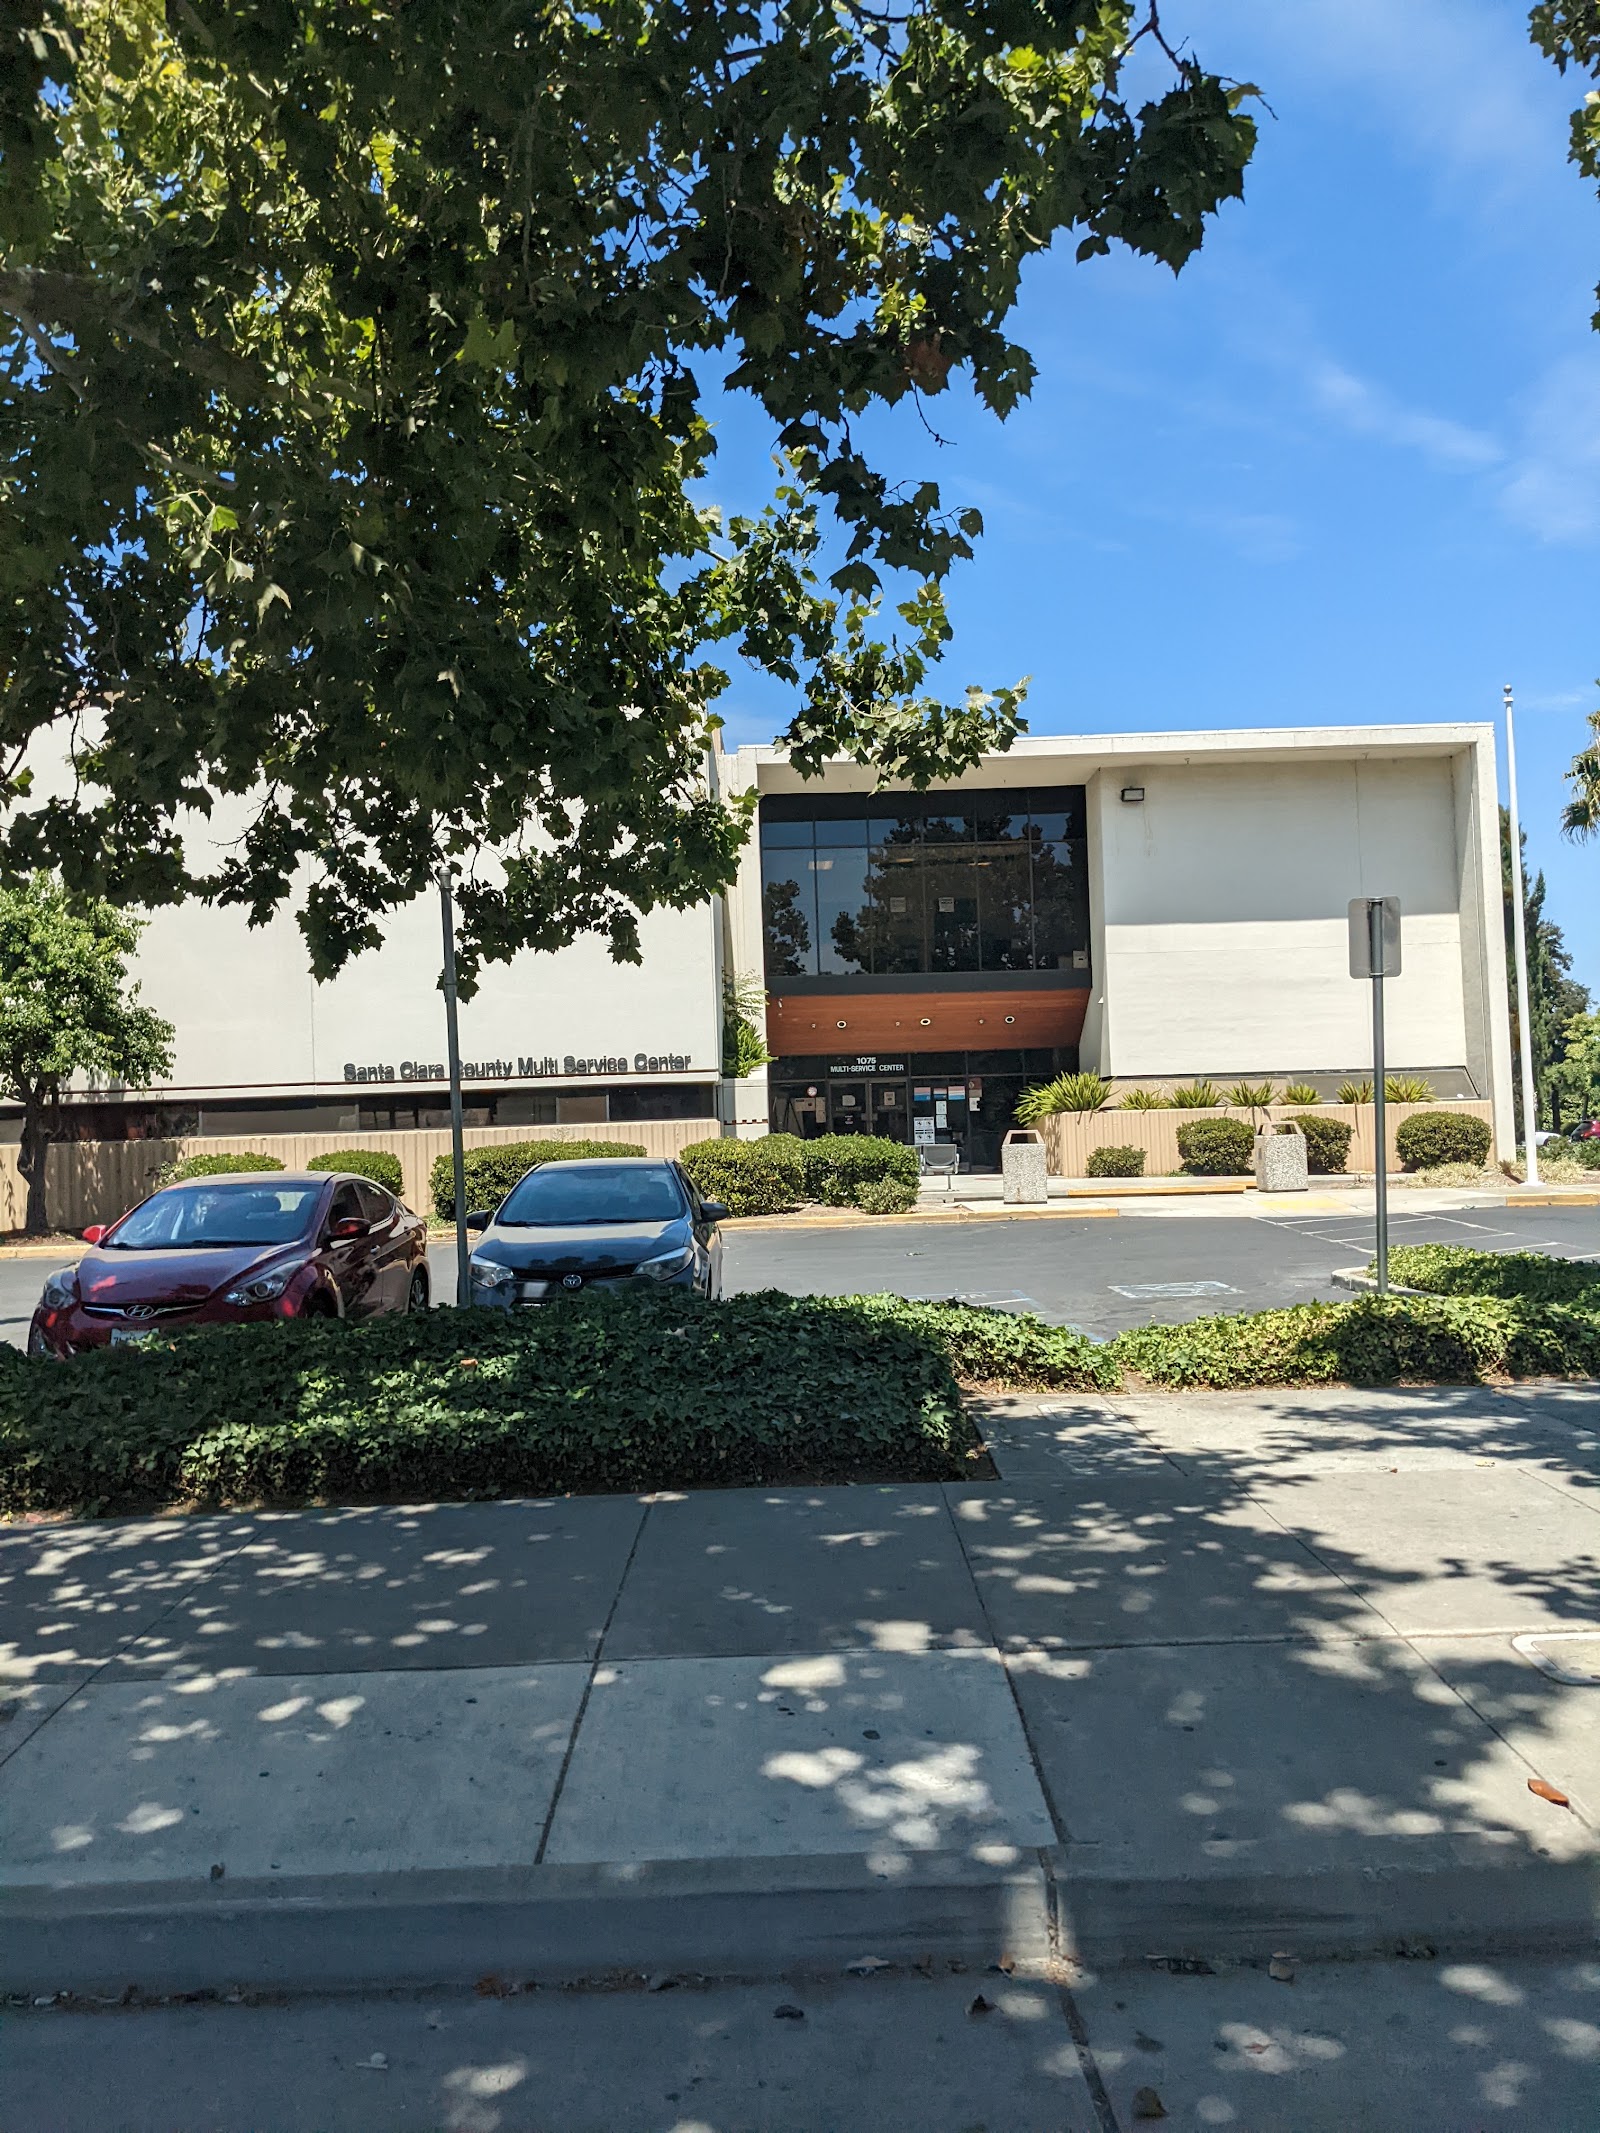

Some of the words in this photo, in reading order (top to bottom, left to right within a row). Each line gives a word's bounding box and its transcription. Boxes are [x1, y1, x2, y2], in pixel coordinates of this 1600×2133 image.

[856, 1057, 877, 1065] 1075
[343, 1063, 395, 1081] Santa
[400, 1061, 445, 1080] Clara
[517, 1056, 559, 1076] Multi
[563, 1055, 628, 1074] Service
[634, 1053, 692, 1072] Center
[879, 1064, 904, 1072] CENTER
